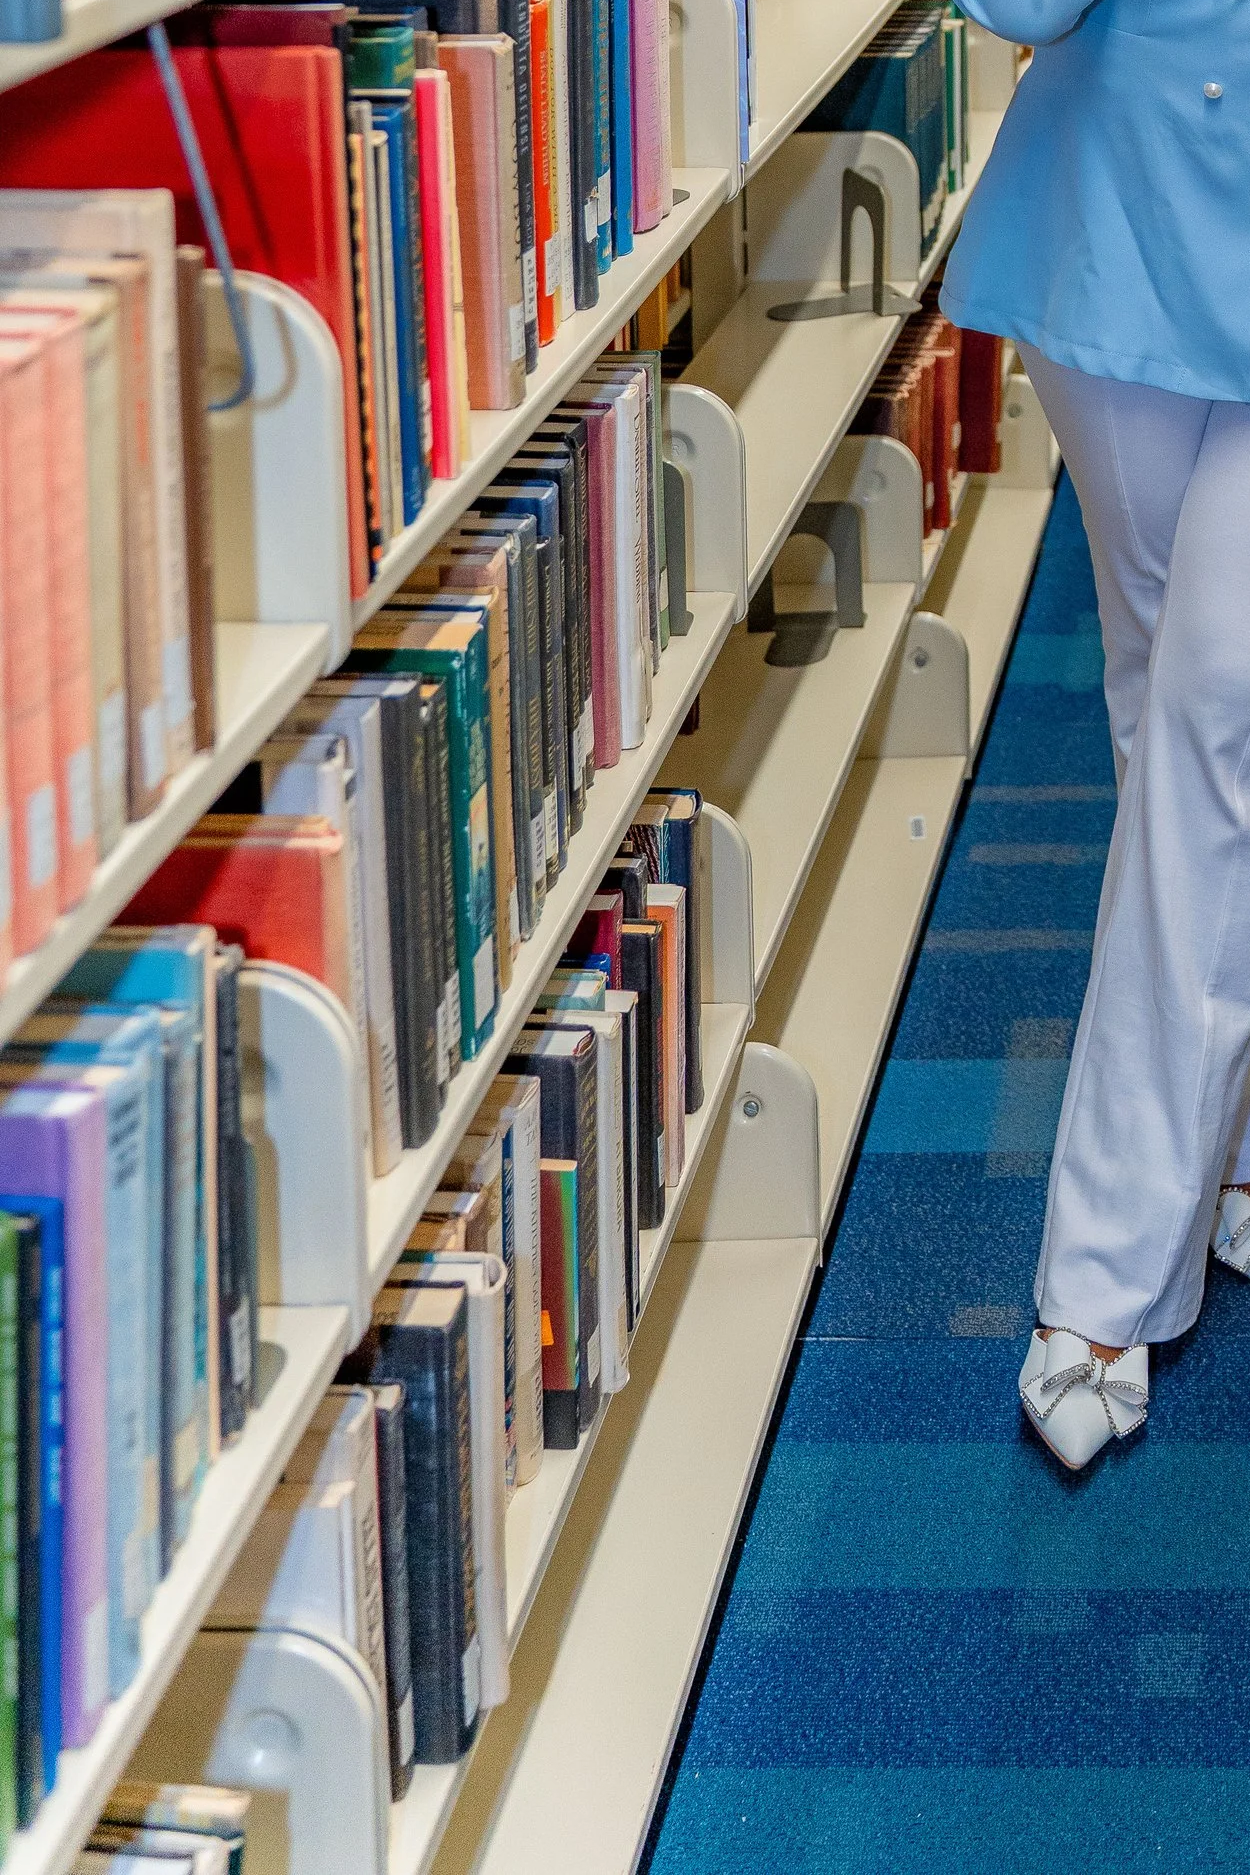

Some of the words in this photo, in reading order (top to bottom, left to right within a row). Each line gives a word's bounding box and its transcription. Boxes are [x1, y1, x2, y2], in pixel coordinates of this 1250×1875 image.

[539, 51, 548, 98] SHALL
[518, 81, 529, 157] DEFENSE
[541, 143, 549, 185] THEM
[524, 182, 532, 212] LISA
[531, 1210, 541, 1275] KITCHEN
